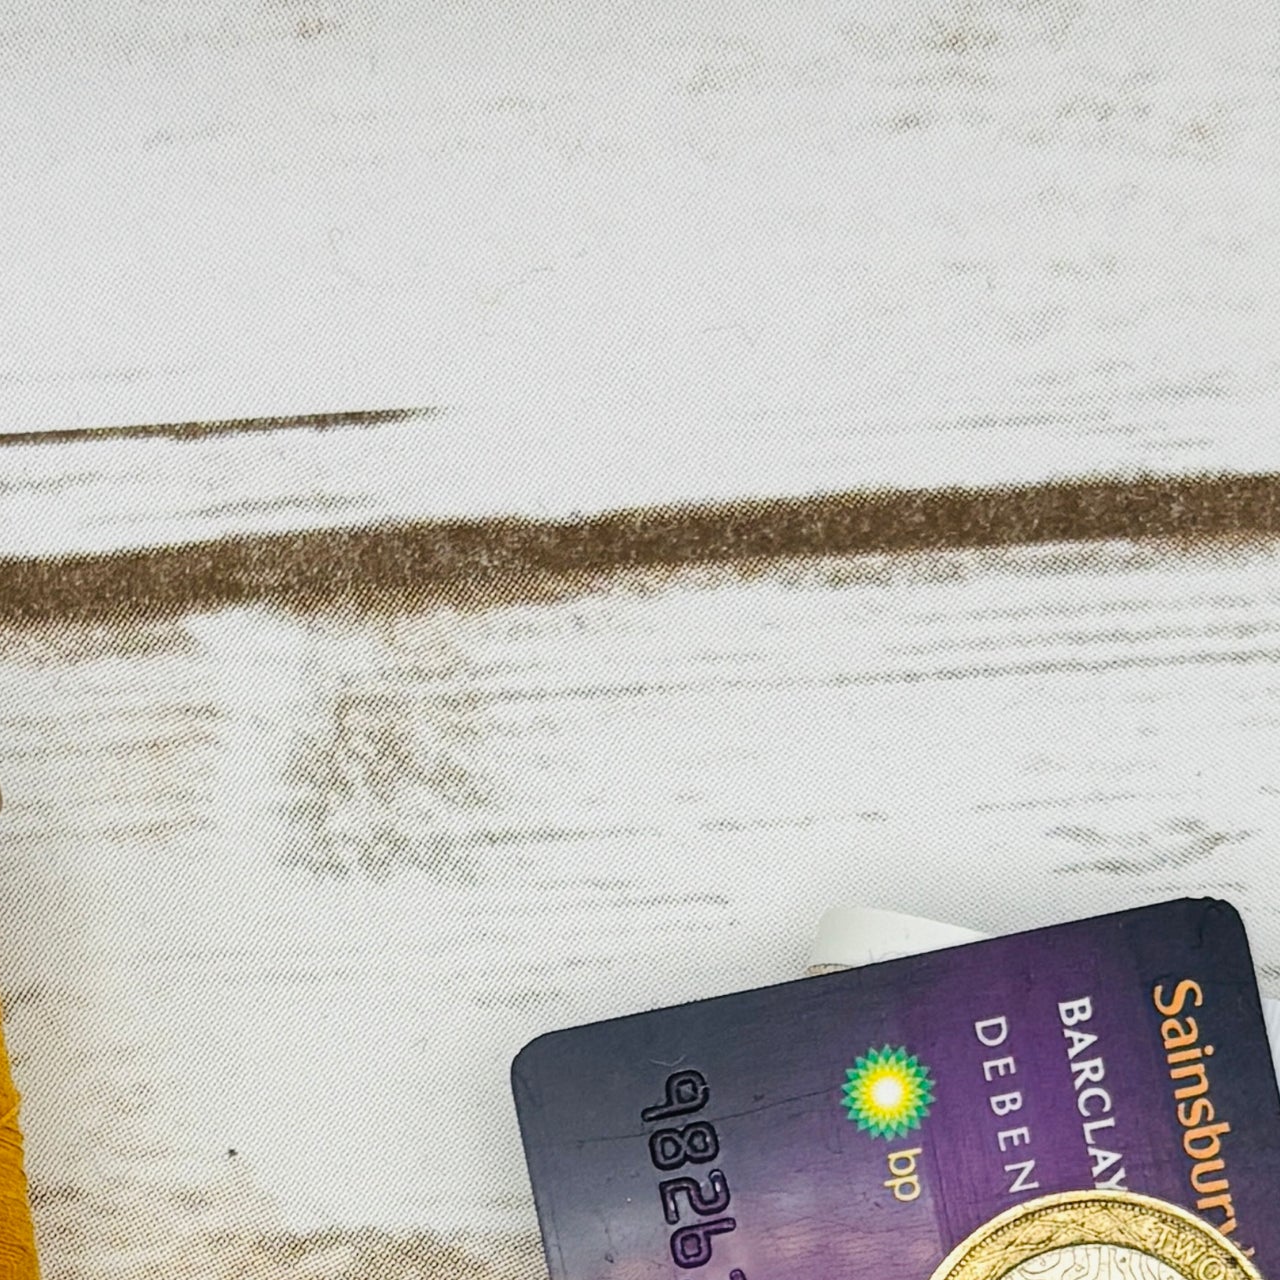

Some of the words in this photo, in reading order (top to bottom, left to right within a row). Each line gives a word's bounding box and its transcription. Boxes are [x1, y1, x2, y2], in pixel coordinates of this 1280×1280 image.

[883, 1147, 923, 1203] bp
[974, 1015, 1040, 1194] DEBEN
[1057, 996, 1129, 1191] BARCLAY
